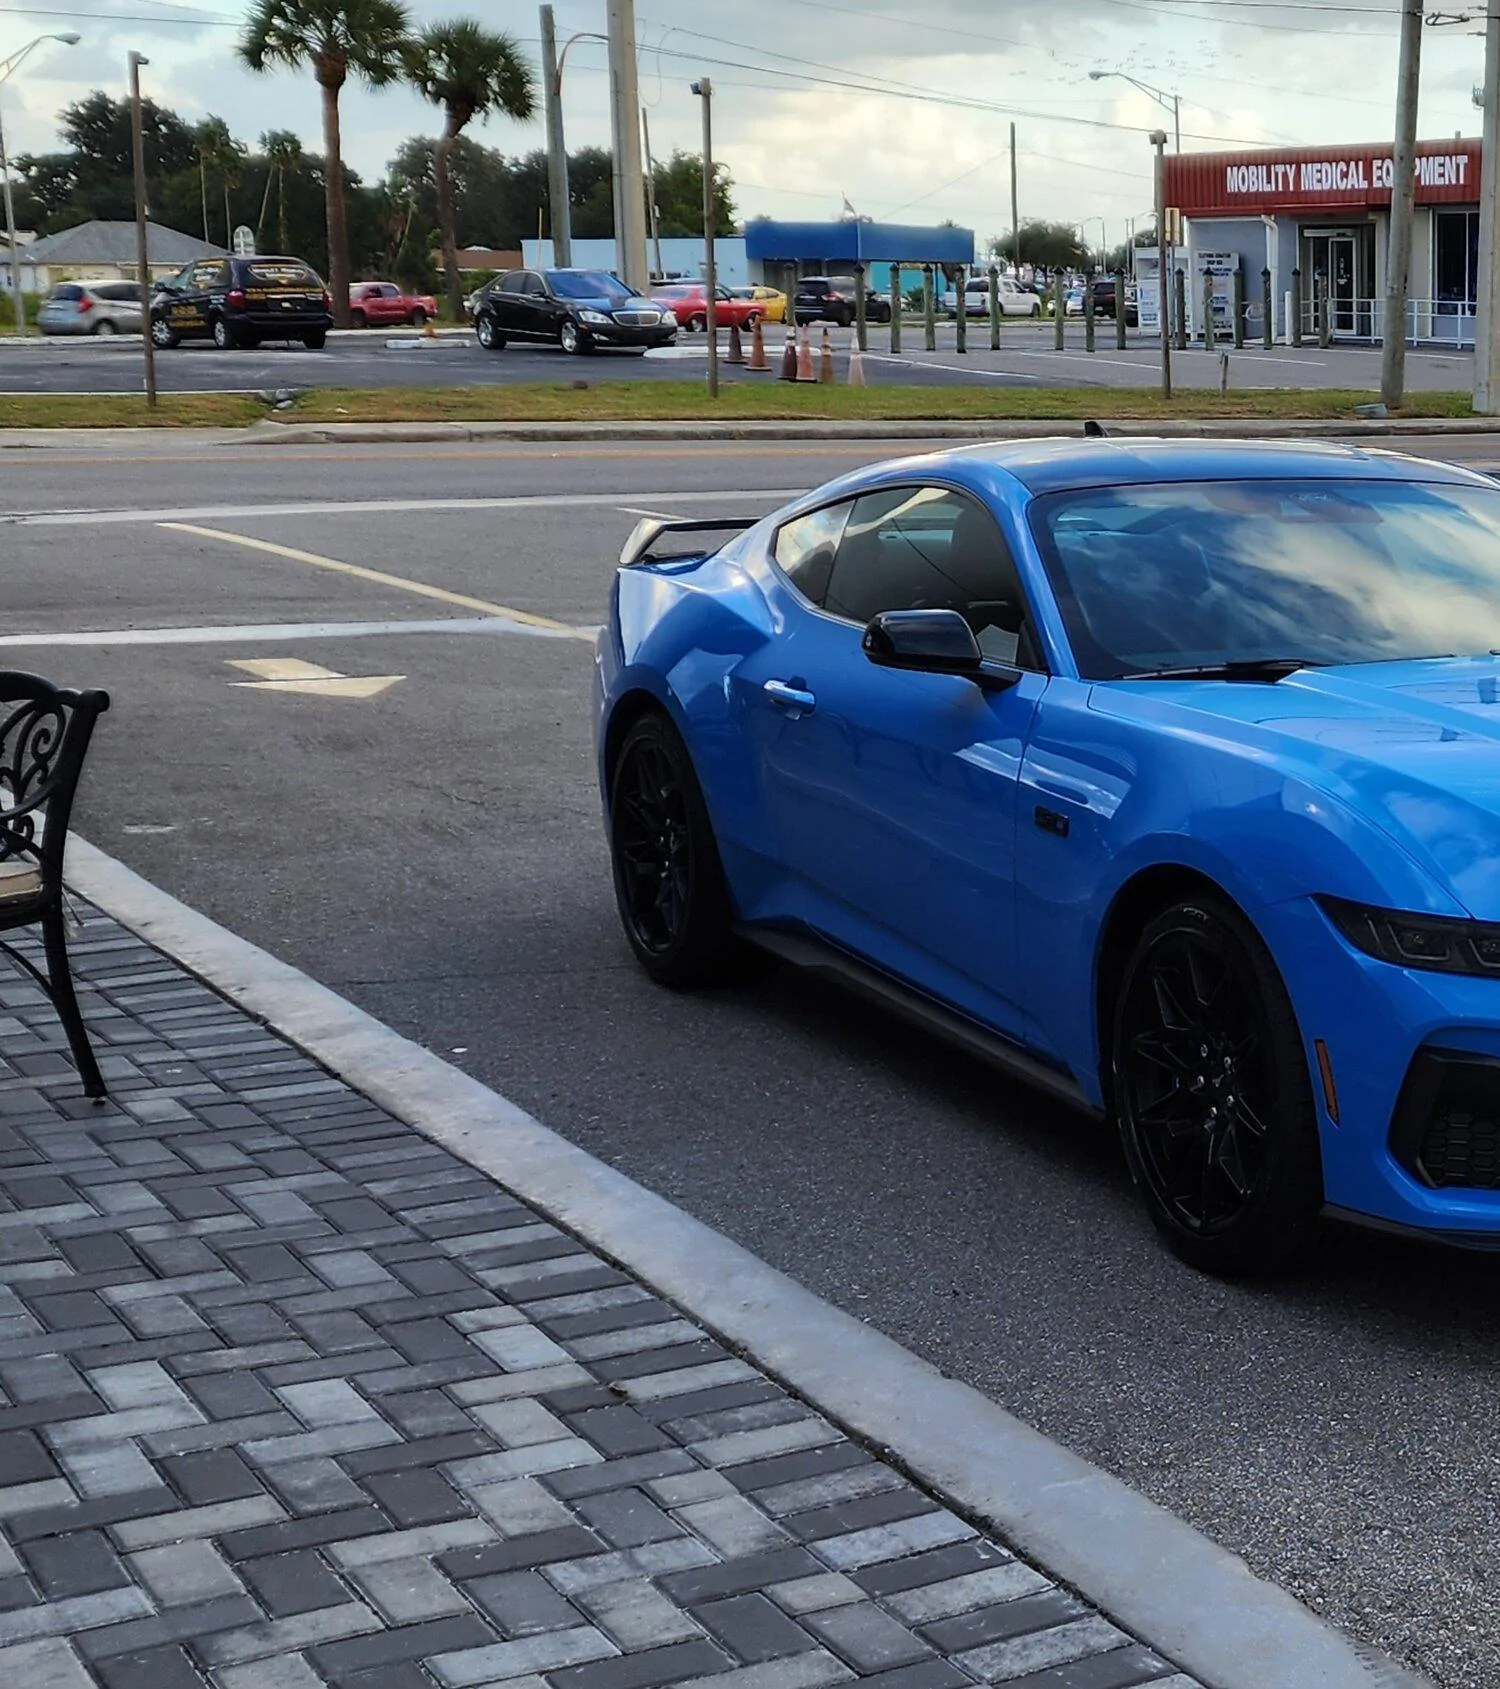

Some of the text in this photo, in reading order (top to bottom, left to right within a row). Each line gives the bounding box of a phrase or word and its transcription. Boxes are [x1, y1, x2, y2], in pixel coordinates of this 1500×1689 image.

[1226, 155, 1468, 192] MOBILITY MEDICAL EQMENT
